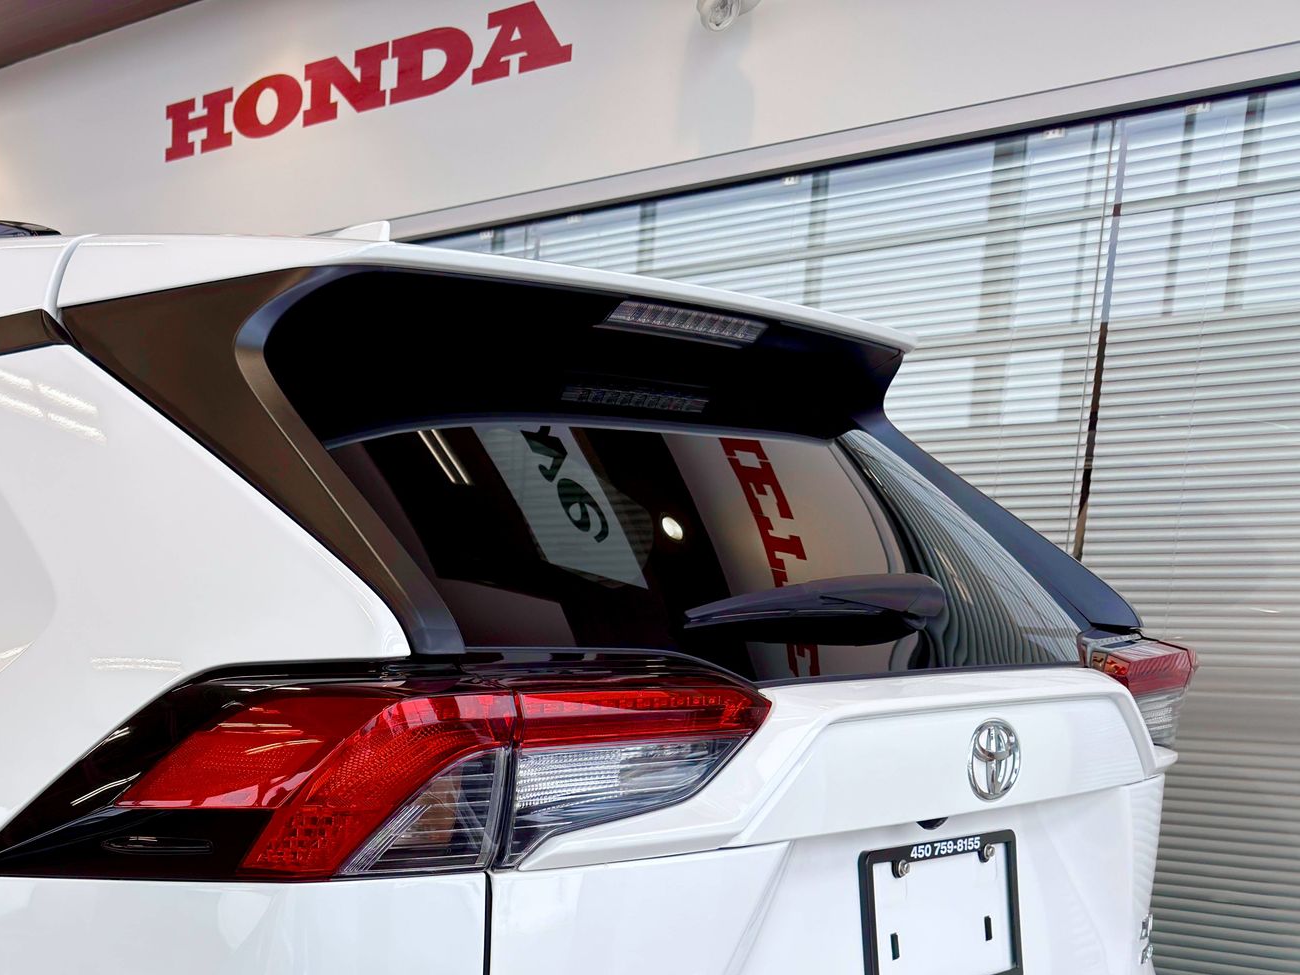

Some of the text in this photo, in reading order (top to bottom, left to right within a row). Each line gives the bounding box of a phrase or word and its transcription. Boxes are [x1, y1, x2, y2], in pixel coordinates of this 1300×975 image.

[165, 1, 573, 163] HONDA
[910, 836, 981, 859] 450 759-8155
